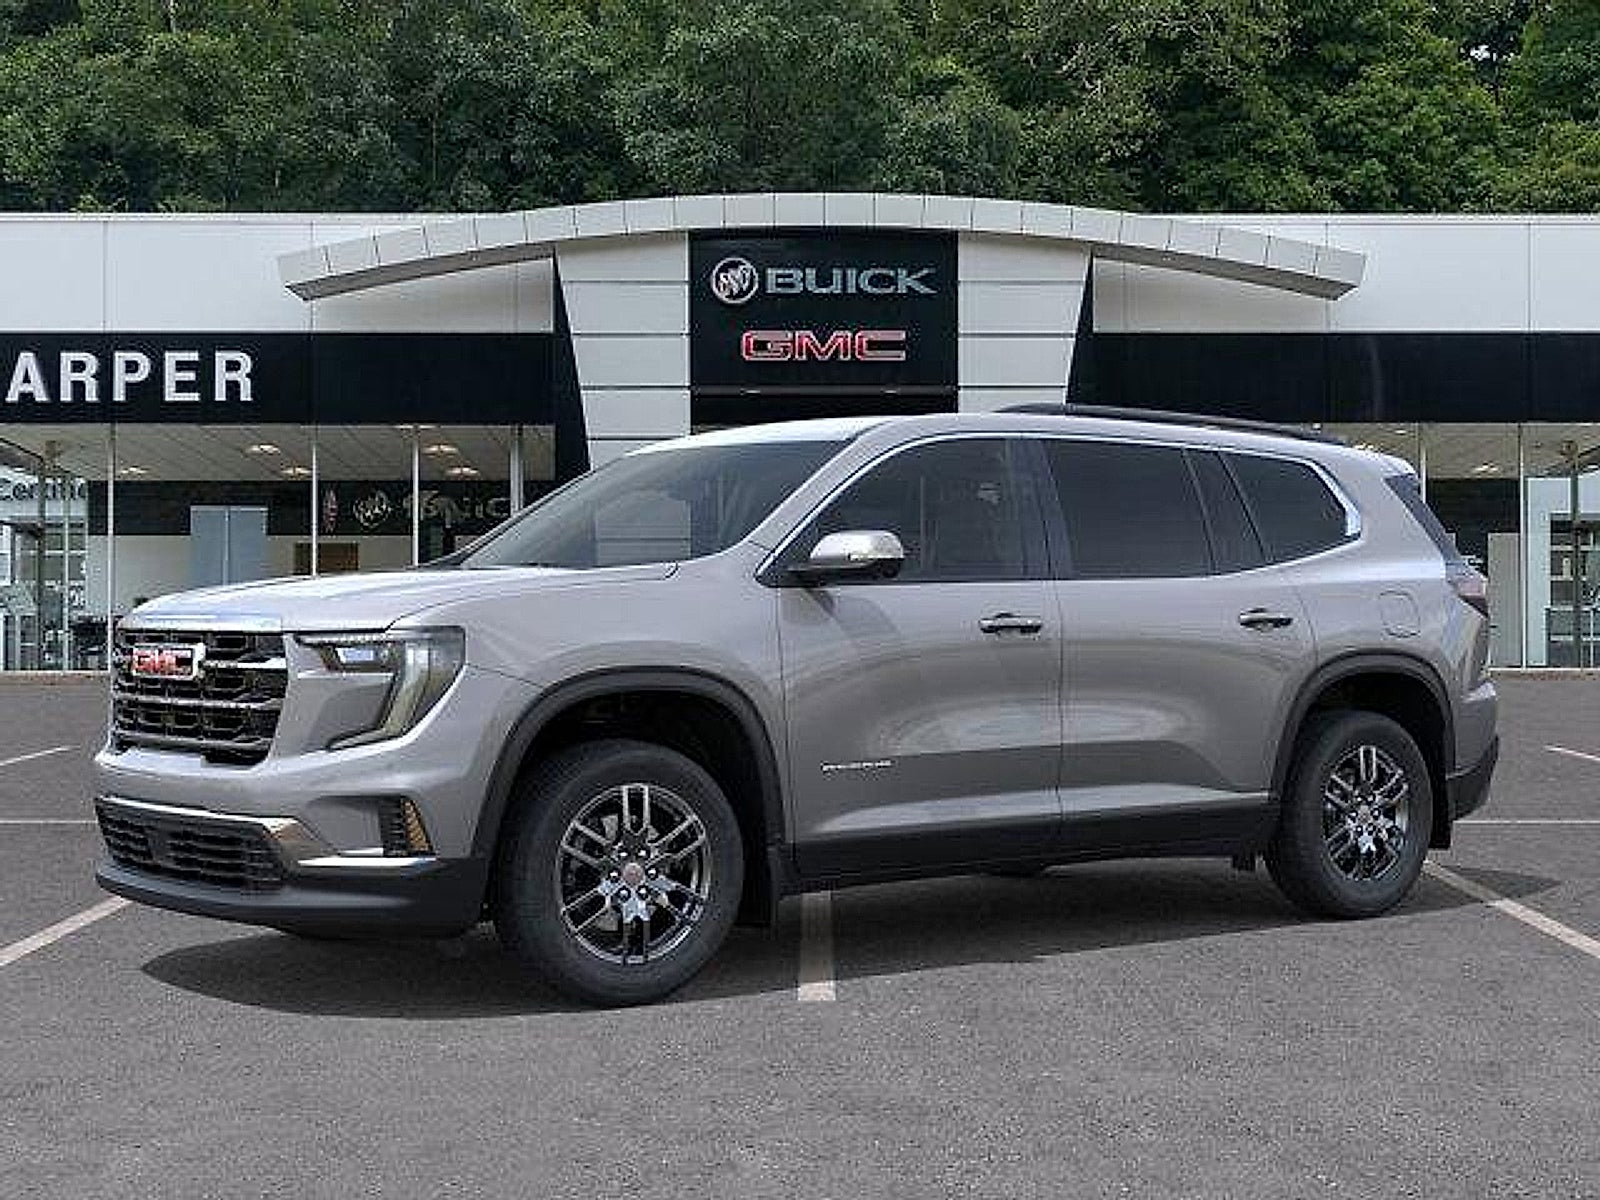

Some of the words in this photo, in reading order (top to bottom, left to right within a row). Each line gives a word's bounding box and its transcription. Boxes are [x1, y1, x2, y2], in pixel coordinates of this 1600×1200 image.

[765, 267, 938, 294] BUICK
[741, 330, 906, 361] GMC
[5, 351, 253, 402] ARPER
[132, 647, 193, 678] GMC
